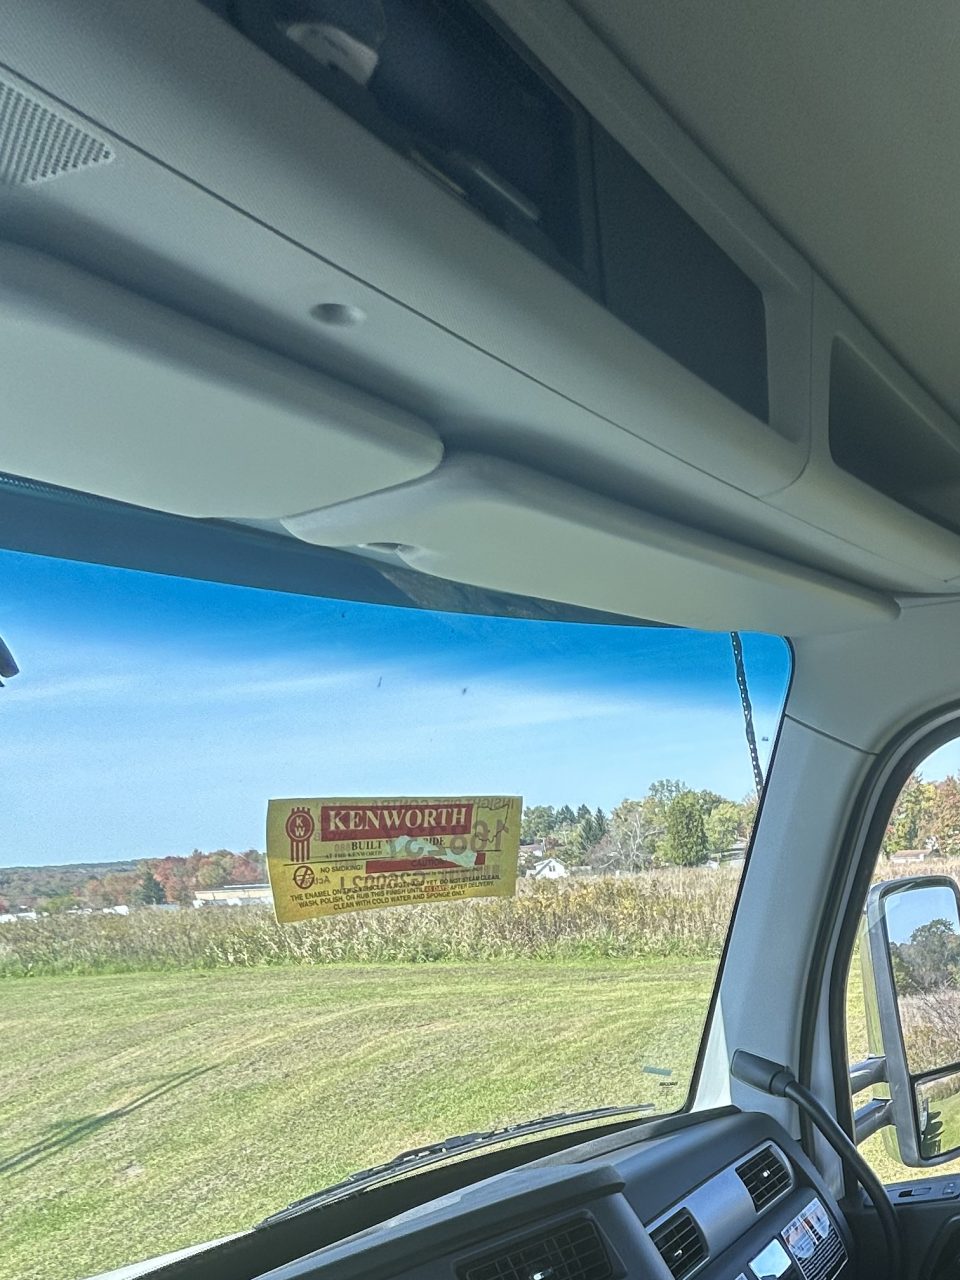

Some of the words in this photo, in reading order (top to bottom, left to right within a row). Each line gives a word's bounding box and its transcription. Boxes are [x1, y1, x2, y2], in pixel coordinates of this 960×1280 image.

[328, 807, 467, 832] KENWORTH
[351, 840, 382, 851] BUILT
[305, 891, 331, 900] ENAMEL
